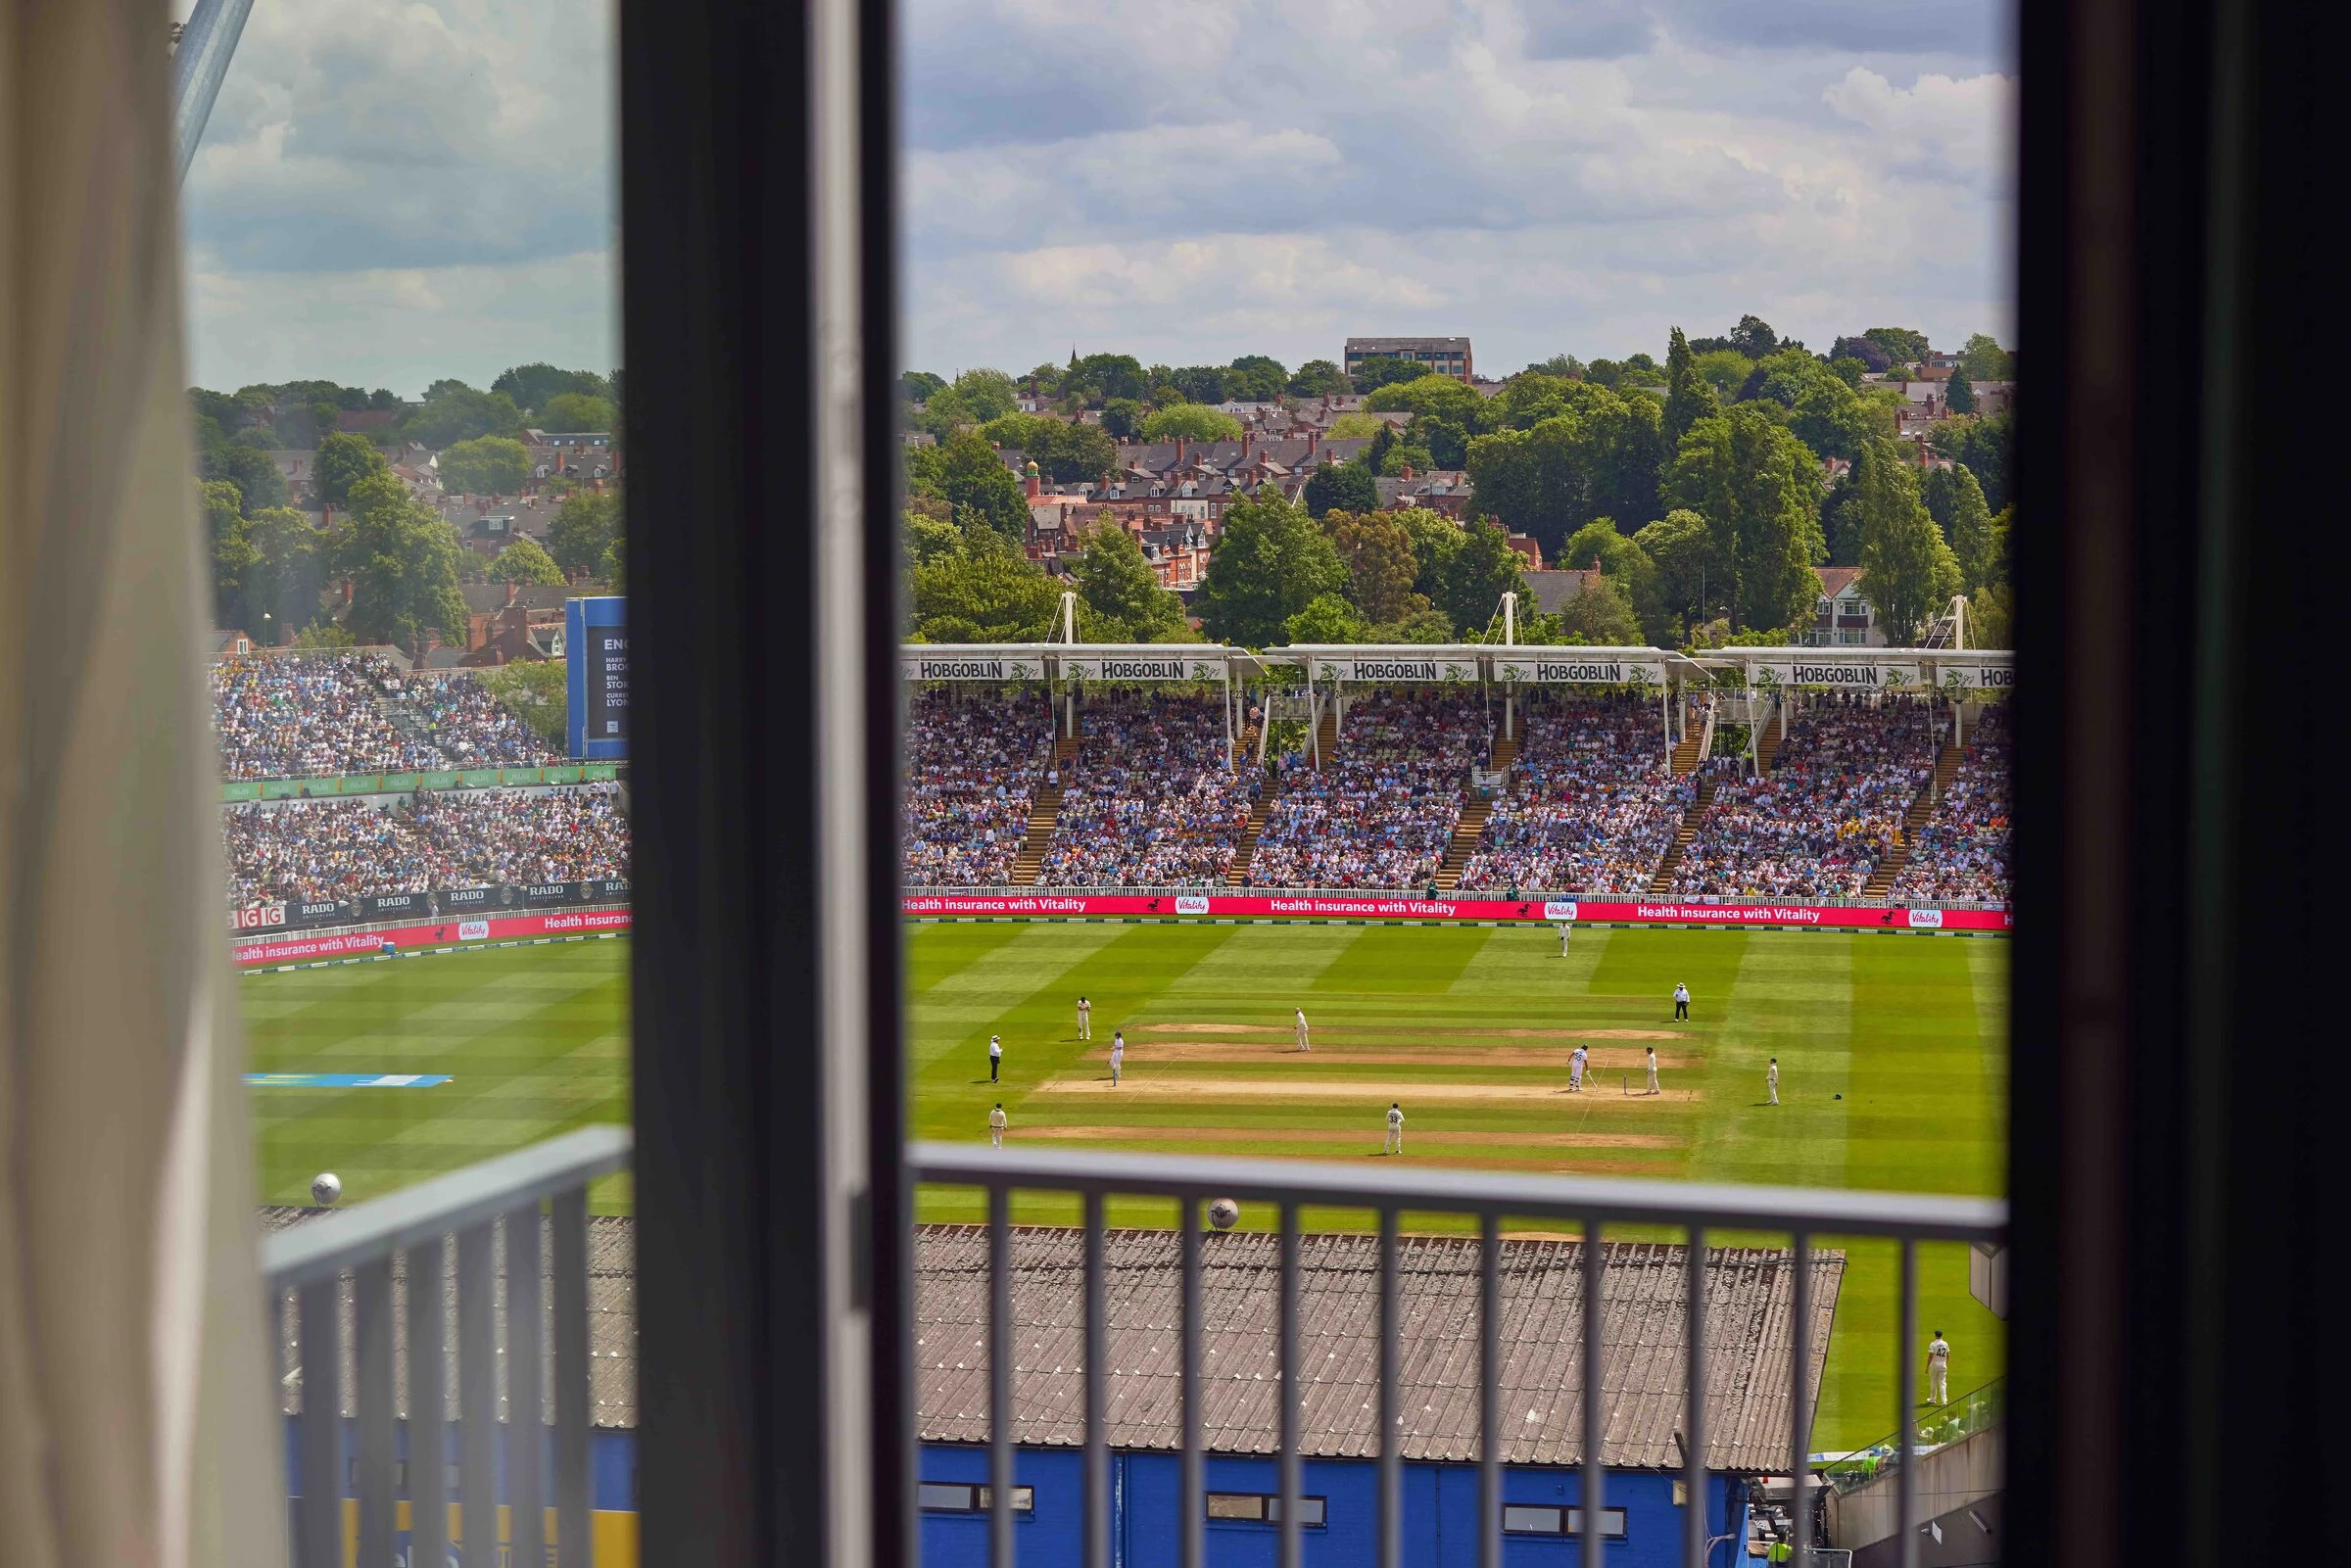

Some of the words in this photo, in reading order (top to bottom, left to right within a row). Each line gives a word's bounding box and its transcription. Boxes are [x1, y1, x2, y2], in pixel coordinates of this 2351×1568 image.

[921, 662, 1002, 679] HOBGOBLIN
[1101, 662, 1184, 679] HOBGOBLIN
[1354, 663, 1436, 680] HOBGOBLIN
[1537, 664, 1621, 681] HOBGOBLIN
[1793, 666, 1878, 685] HOBGOBLIN
[1235, 689, 1243, 699] 23
[1335, 689, 1343, 699] 24
[1678, 691, 1686, 702] 25
[451, 890, 484, 901] RADO
[530, 885, 563, 896] RADO
[377, 896, 410, 907] RADO
[902, 899, 941, 910] Health
[945, 899, 1005, 910] insurance
[1008, 899, 1036, 910] with
[1039, 899, 1086, 912] Vitality
[1178, 898, 1206, 912] Vitality
[1271, 900, 1312, 911] Health
[1315, 900, 1375, 912] insurance
[1378, 901, 1406, 913] with
[1410, 902, 1456, 916] Vitality
[302, 903, 334, 915] RADO
[1547, 903, 1574, 918] Vitality
[1638, 906, 1676, 918] Health
[1681, 906, 1740, 919] insurance
[1744, 907, 1771, 920] with
[1773, 908, 1820, 923] Vitality
[241, 910, 259, 927] IG
[265, 908, 281, 925] IG
[545, 915, 582, 928] Health
[1912, 912, 1939, 926] Vitality
[461, 923, 486, 935] Vitality
[265, 943, 316, 958] insurance
[319, 938, 343, 951] with
[345, 935, 384, 949] Vitality
[1936, 1348, 1946, 1357] 42
